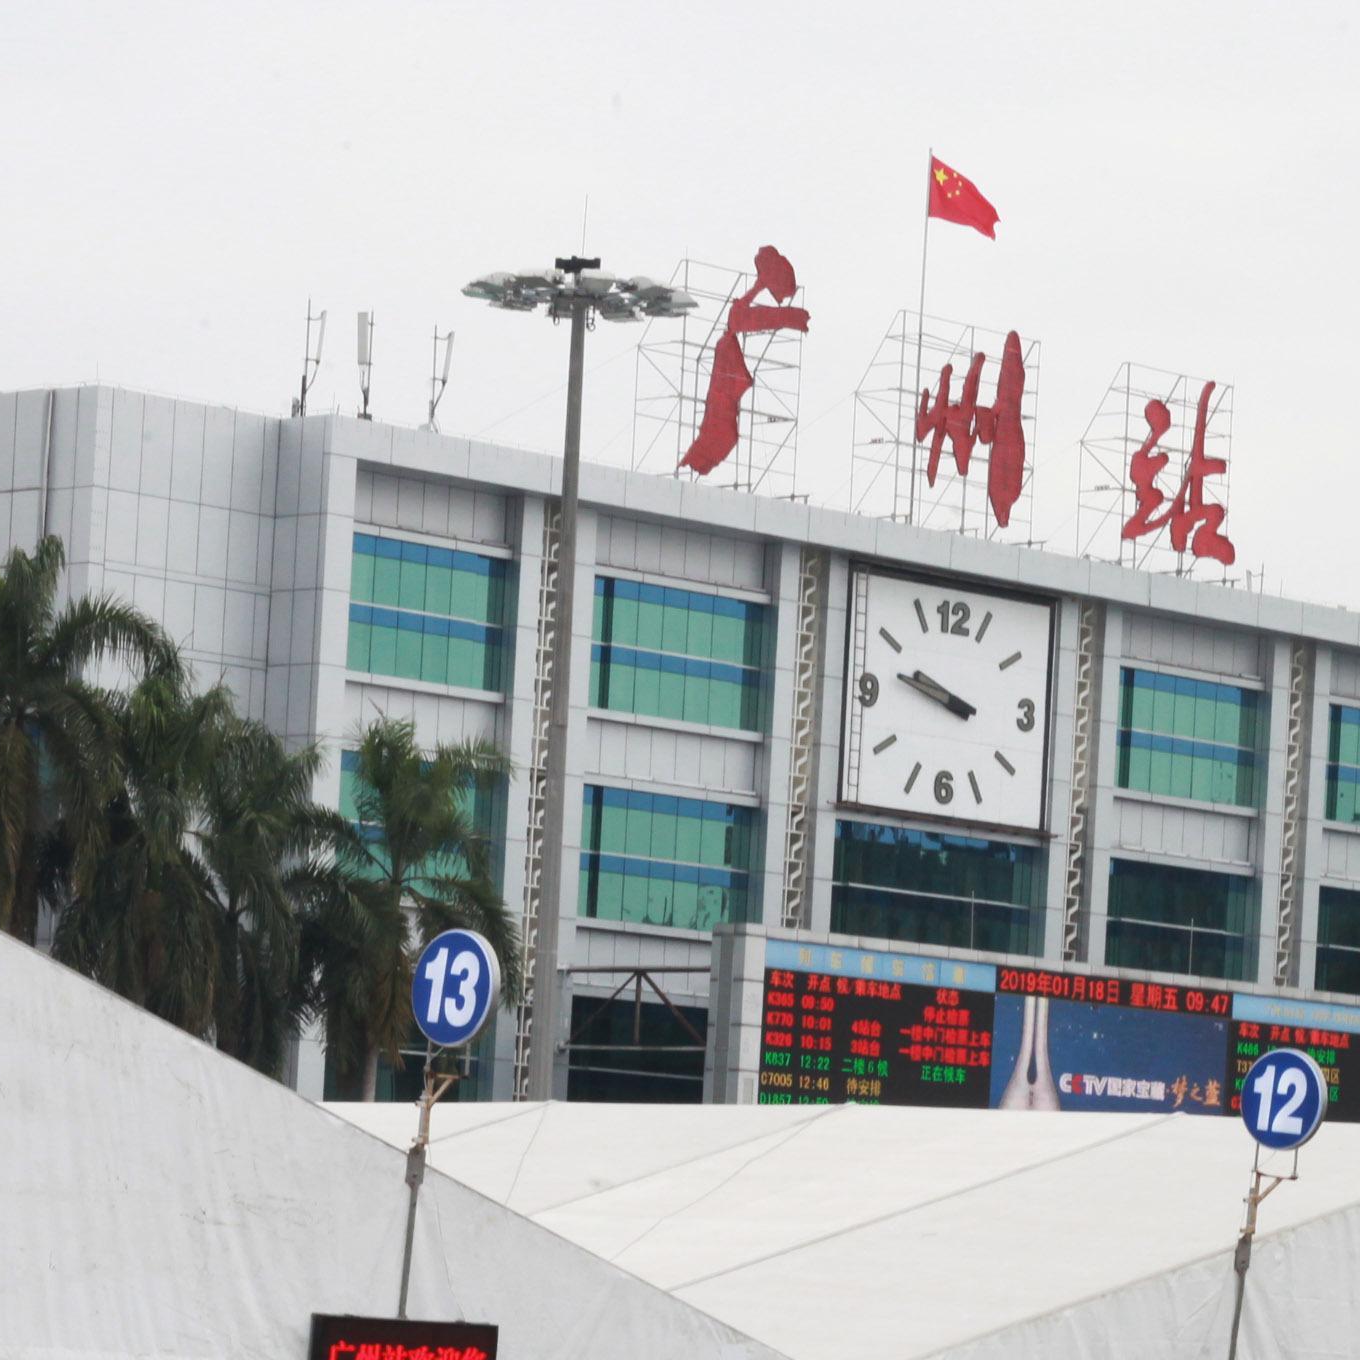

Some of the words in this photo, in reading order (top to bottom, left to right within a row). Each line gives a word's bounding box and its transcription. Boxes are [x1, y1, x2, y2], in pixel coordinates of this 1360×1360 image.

[679, 246, 1236, 566] 广州站
[937, 601, 971, 636] 12
[859, 673, 879, 708] 9
[1016, 698, 1034, 732] 3
[933, 770, 953, 804] 6
[425, 948, 480, 1027] 13
[1000, 969, 1120, 1005] 2019年01月18日
[1130, 983, 1178, 1010] 星期五
[1186, 991, 1230, 1014] 09:47
[800, 1055, 831, 1071] 12:22
[921, 1065, 967, 1085] 正在候车
[846, 1078, 881, 1096] 待安排
[1253, 1065, 1307, 1135] 12
